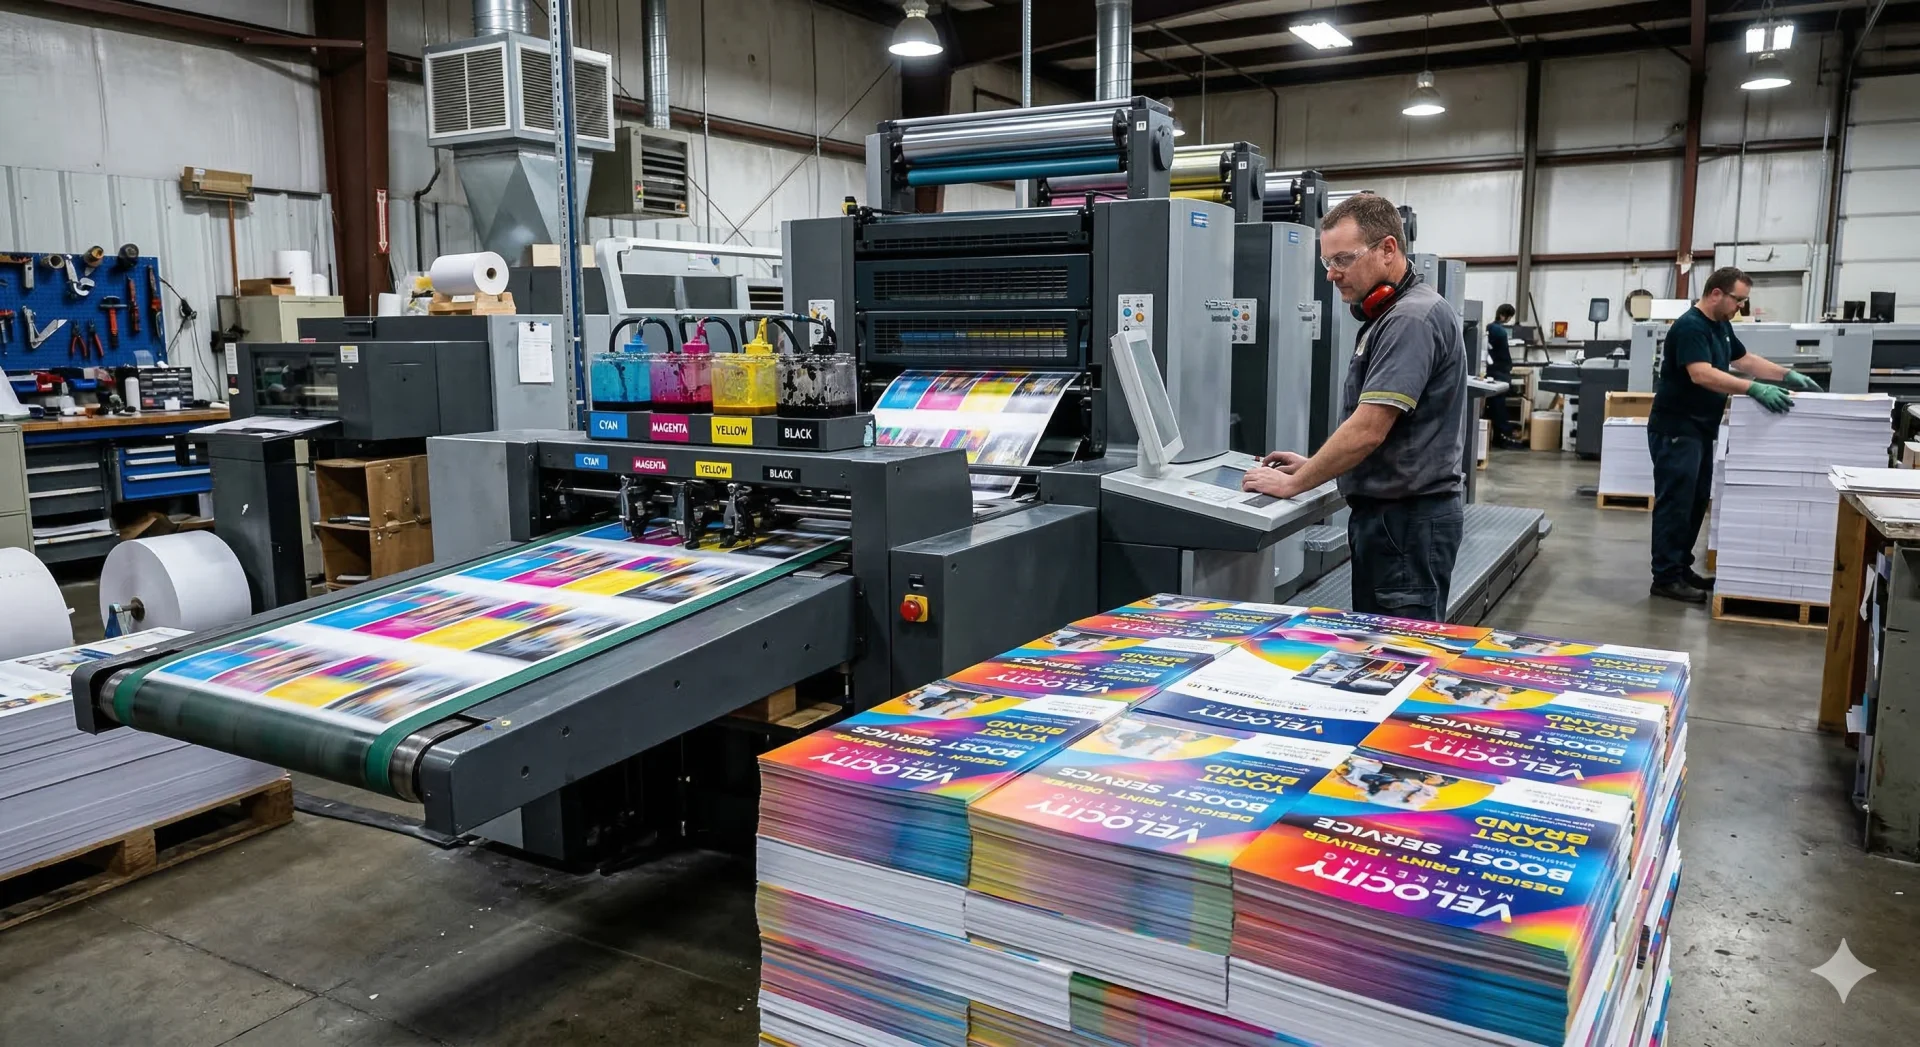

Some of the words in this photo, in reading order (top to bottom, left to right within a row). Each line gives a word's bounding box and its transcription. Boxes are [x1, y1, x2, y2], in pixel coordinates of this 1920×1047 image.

[599, 420, 618, 430] CYAN
[652, 422, 688, 433] MAGENTA
[716, 425, 747, 436] YELLOW
[784, 428, 812, 439] BLACK
[583, 457, 599, 466] CYAN
[635, 460, 666, 470] MAGENTA
[700, 465, 728, 474] YELLOW
[769, 469, 793, 479] BLACK
[986, 670, 1109, 694] VELOCITY
[986, 720, 1067, 735] BRAND
[1188, 707, 1323, 734] VELOCITY
[1545, 714, 1637, 734] BRAND
[973, 728, 1047, 743] YOOST
[1544, 722, 1630, 741] YOOST
[940, 742, 1026, 758] BOOST
[1528, 735, 1626, 756] BOOST
[809, 752, 953, 784] VELOCITY
[1409, 741, 1584, 780] VELOCITY
[1196, 774, 1284, 794] YOOST
[1204, 765, 1300, 785] BRAND
[1116, 793, 1166, 807] PRINT
[1168, 789, 1269, 813] BOOST
[1025, 800, 1198, 843] VELOCITY
[1475, 816, 1589, 845] BRAND
[1302, 830, 1380, 856] DELIVER
[1313, 817, 1442, 854] SERVICE
[1470, 829, 1579, 857] YOOST
[1397, 855, 1460, 874] PRINT
[1450, 849, 1573, 882] BOOST
[1295, 860, 1512, 923] VELOCITY
[1481, 872, 1564, 895] DESIGN
